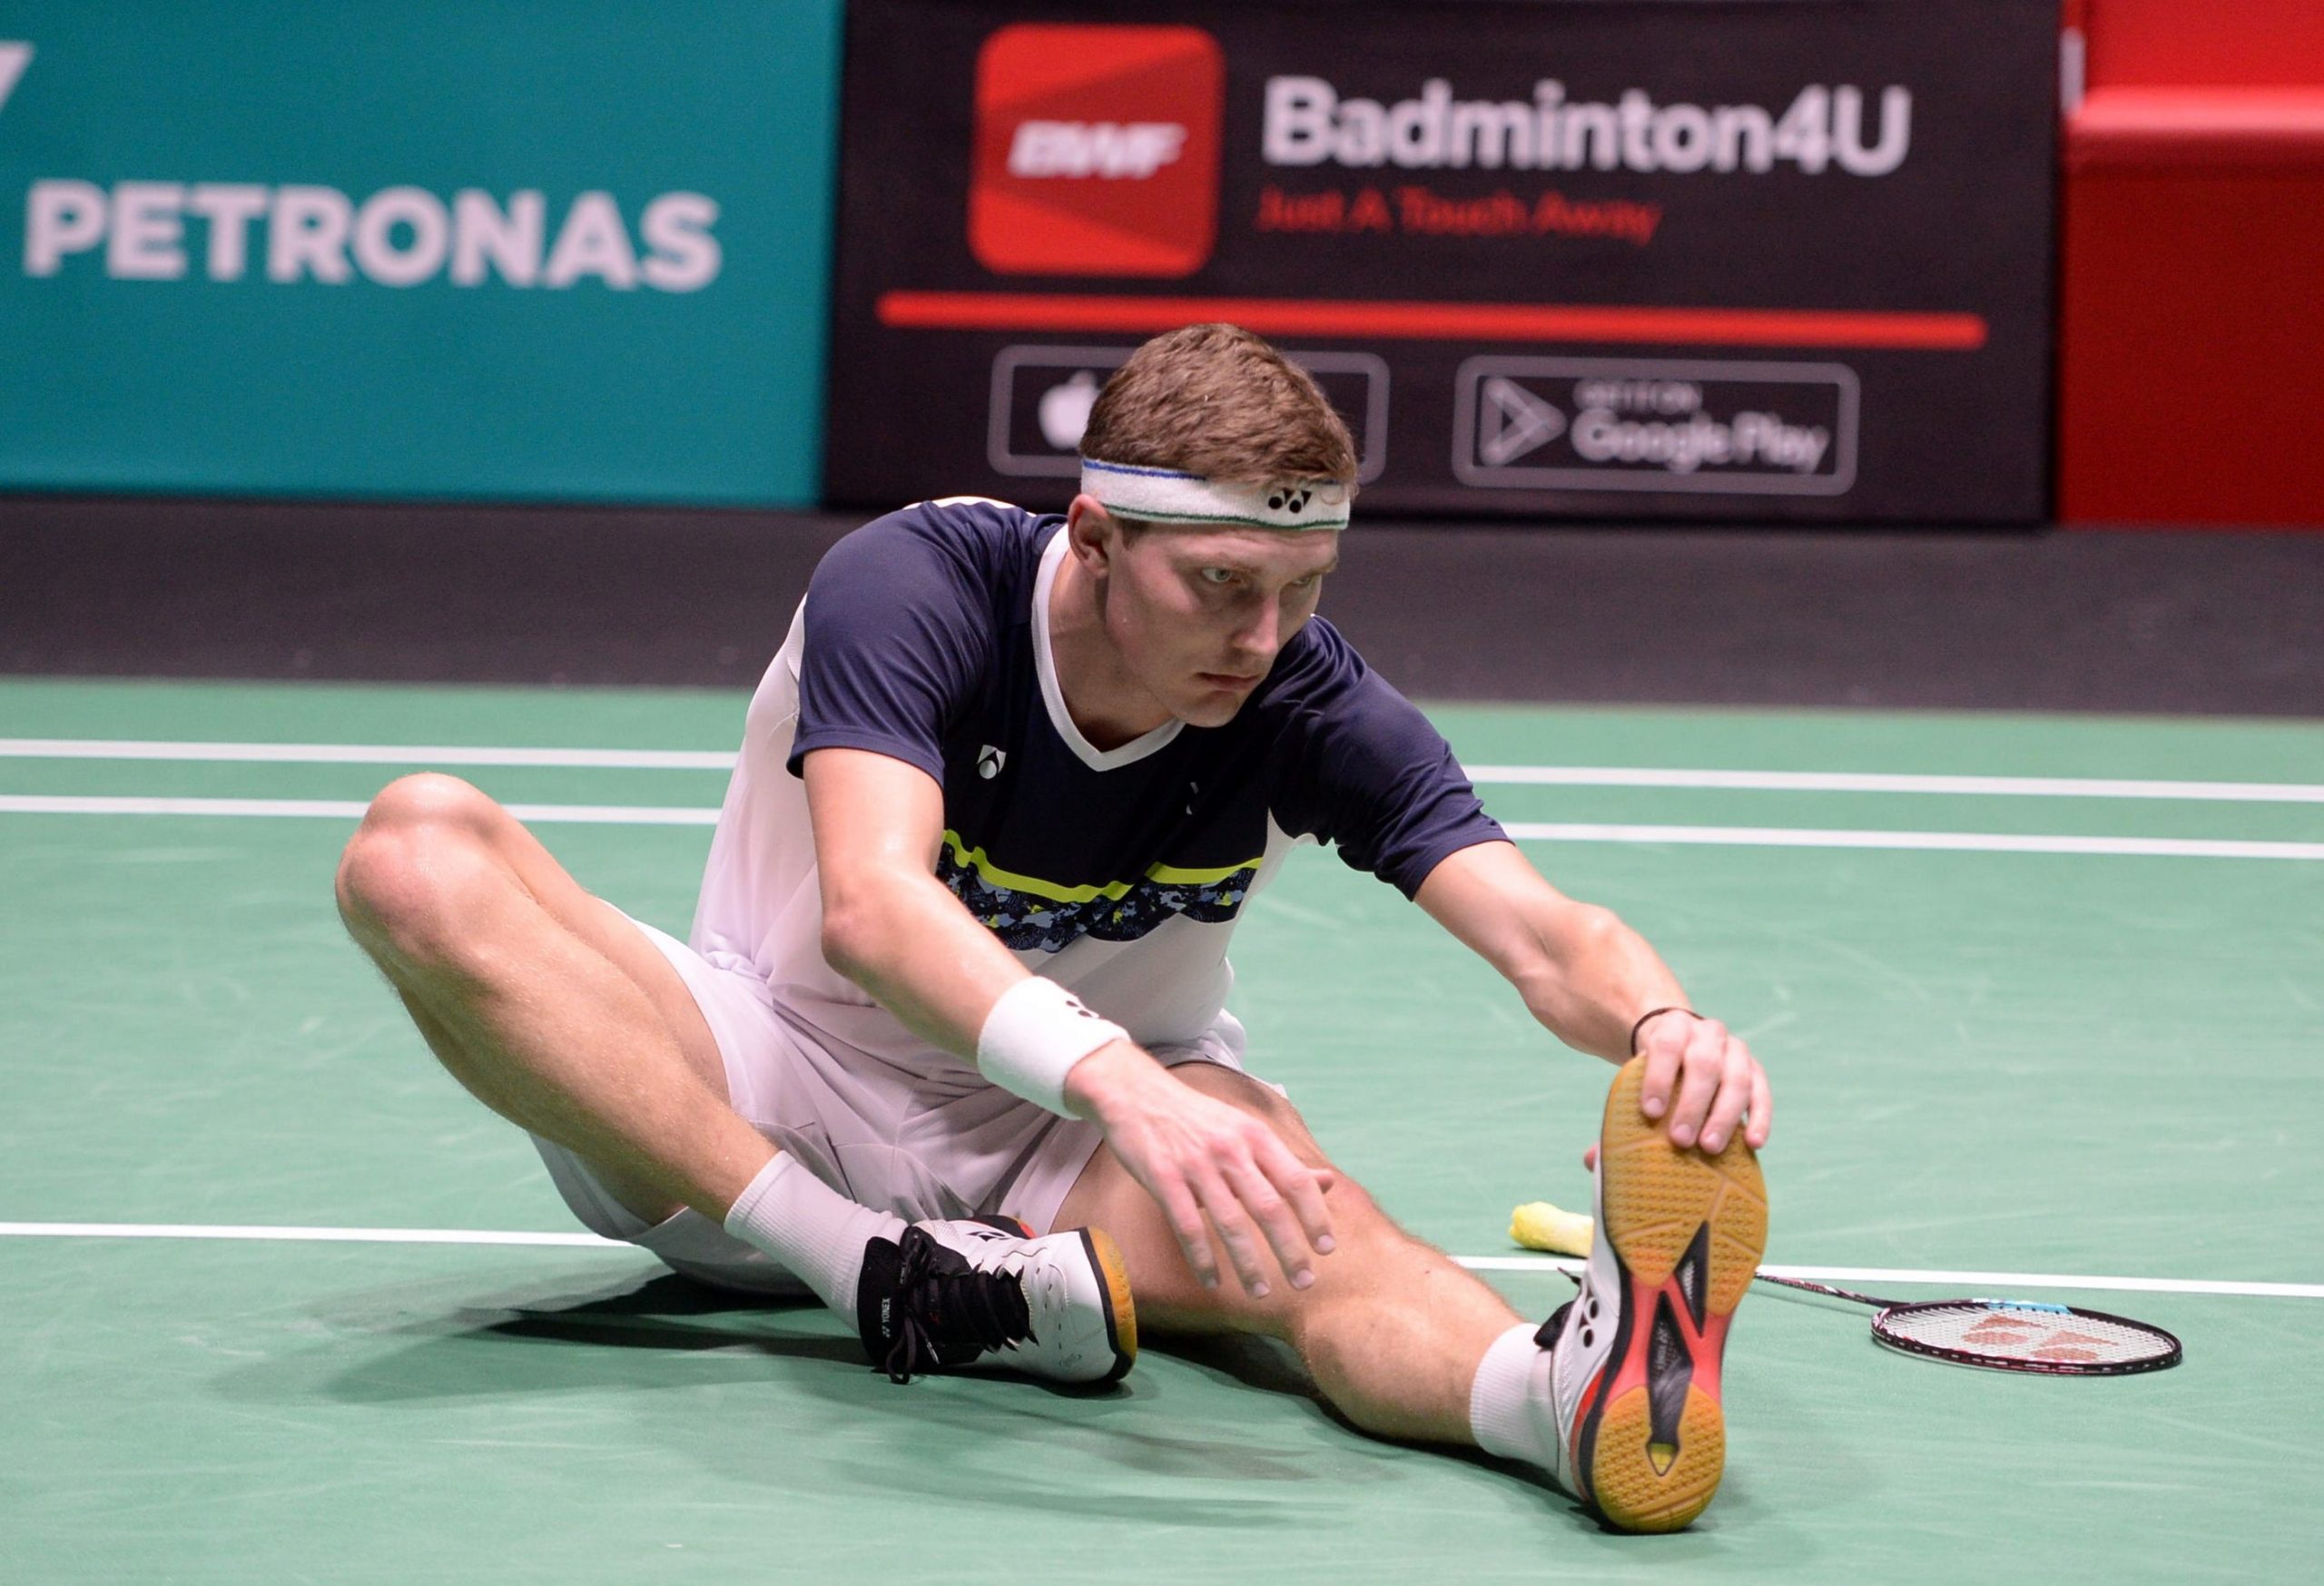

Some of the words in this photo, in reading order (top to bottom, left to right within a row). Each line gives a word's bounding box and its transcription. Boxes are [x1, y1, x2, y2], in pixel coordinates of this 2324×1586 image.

[1264, 77, 1911, 175] Badminton4U
[25, 180, 723, 292] PETRONAS
[1349, 187, 1392, 233] A
[881, 1297, 891, 1324] YONEX
